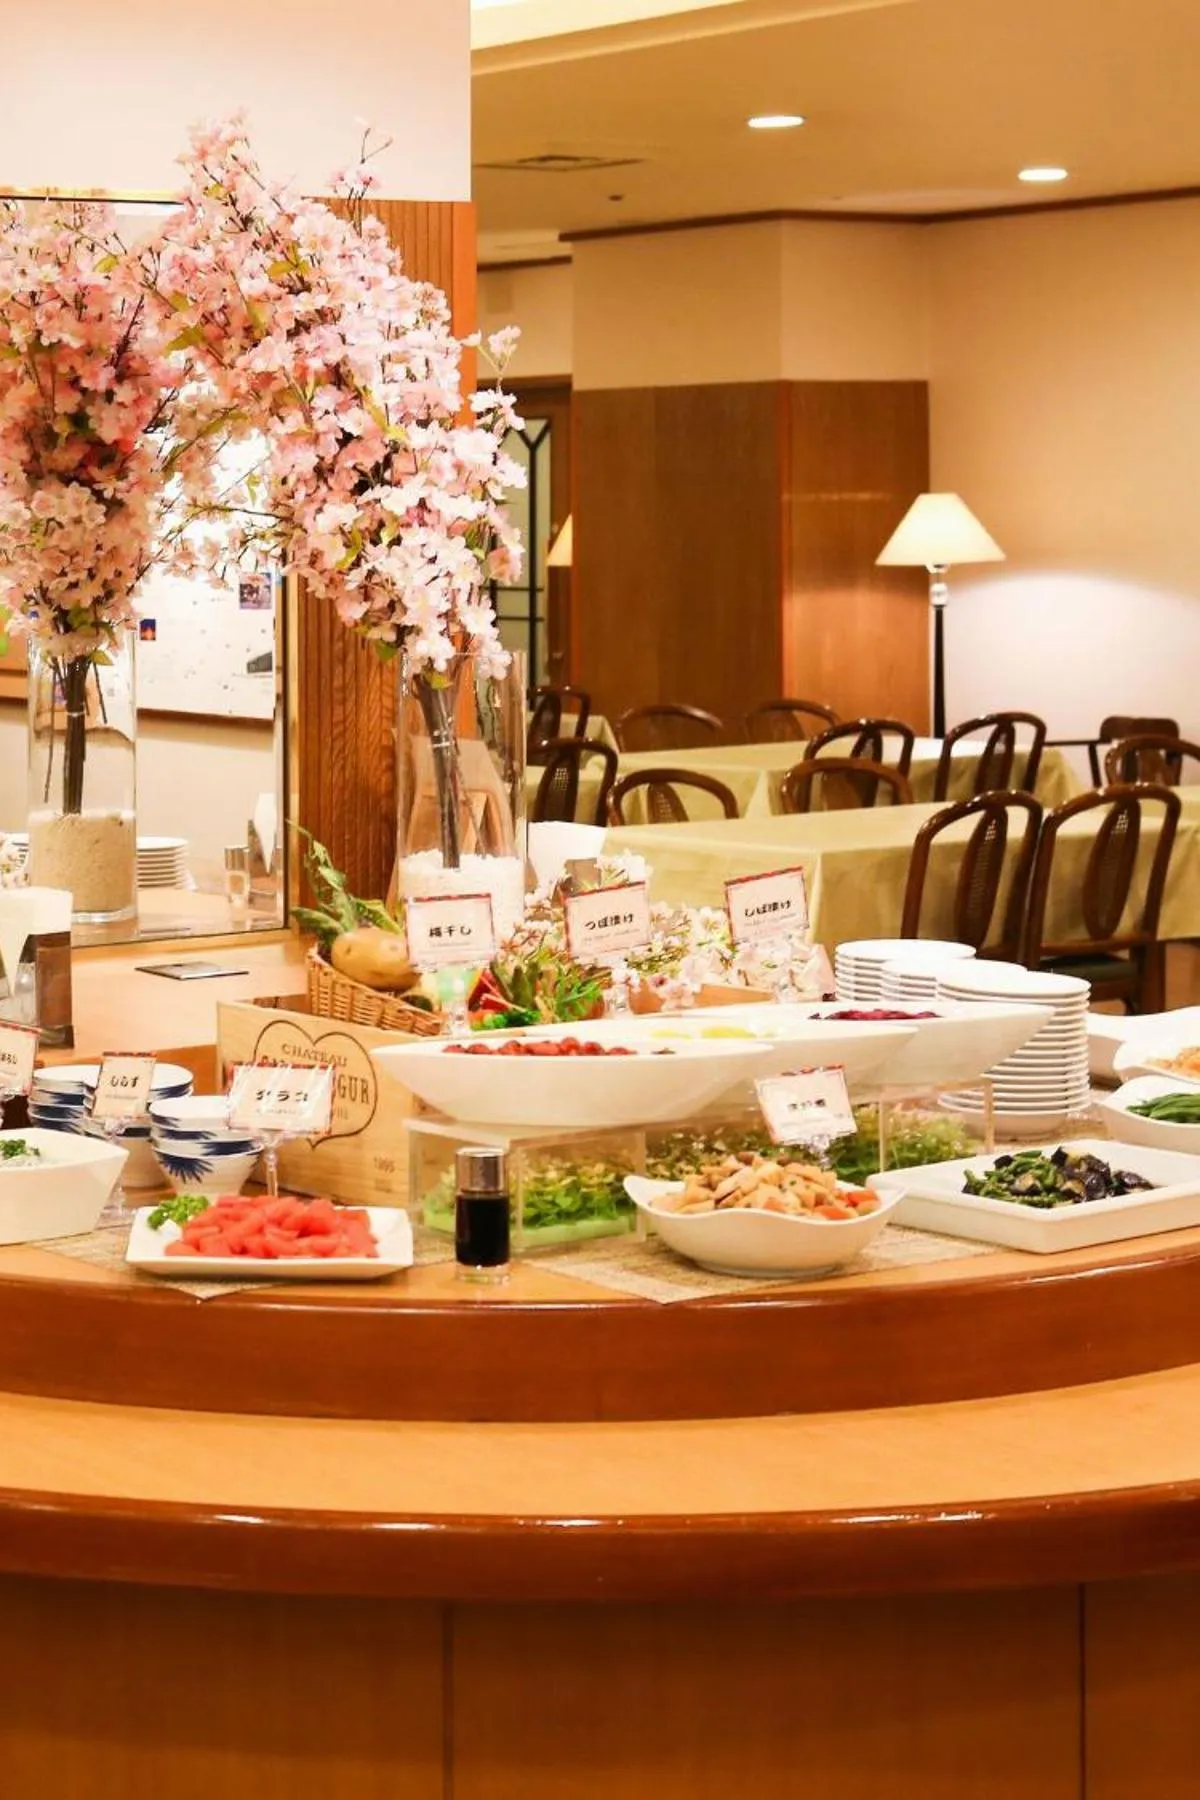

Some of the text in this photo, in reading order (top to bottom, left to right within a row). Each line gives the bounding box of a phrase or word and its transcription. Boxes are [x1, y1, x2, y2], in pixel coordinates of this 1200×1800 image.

[584, 913, 635, 931] つぼ漬け
[428, 925, 472, 939] 梅干し
[280, 1042, 348, 1068] CHATEAU
